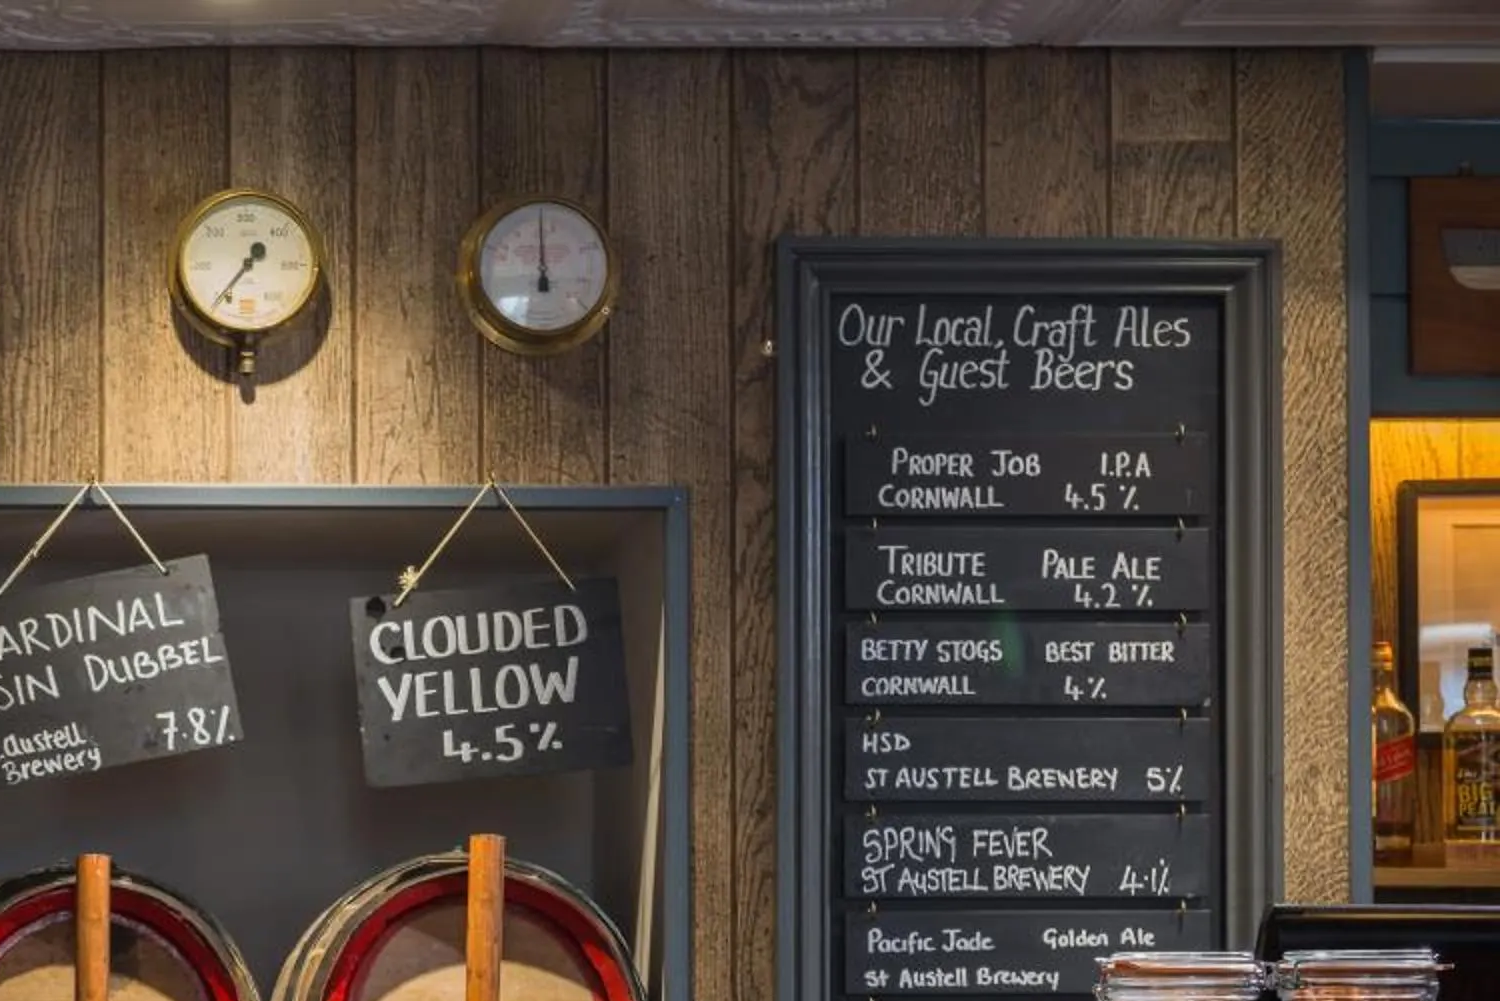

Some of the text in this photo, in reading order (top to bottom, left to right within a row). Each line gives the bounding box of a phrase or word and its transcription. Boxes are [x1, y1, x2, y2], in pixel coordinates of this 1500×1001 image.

[839, 303, 904, 346] Our
[1013, 304, 1097, 362] Craft
[1114, 304, 1192, 347] Ales
[861, 348, 1135, 406] & Guest Beers
[891, 447, 1041, 477] PROPER JOB
[877, 484, 1005, 509] CORNWALL
[877, 545, 987, 577] TRIBUTE
[1041, 549, 1162, 580] PALE ALE
[876, 579, 1006, 605] CORNWALL
[369, 605, 588, 664] CLOUDED
[84, 636, 224, 693] DUBBEL
[861, 639, 1004, 663] BETTY STOGS
[1045, 641, 1176, 664] BEST BITTER
[377, 656, 579, 721] YELLOW
[861, 675, 976, 696] CORNWALL
[863, 733, 912, 753] HSD
[1, 747, 102, 785] Brewery
[864, 768, 888, 789] ST
[894, 767, 999, 789] AUSTELL
[1007, 767, 1119, 791] BREWERY
[862, 825, 1054, 864] SPRING FEVER
[861, 863, 895, 894] ST
[898, 867, 989, 896] AUSTELL
[993, 865, 1092, 896] BREWERY
[867, 928, 996, 955] Pacific Jade
[1043, 927, 1156, 948] Golden Ale
[899, 967, 968, 989] Austell
[976, 967, 1060, 991] Brewery
